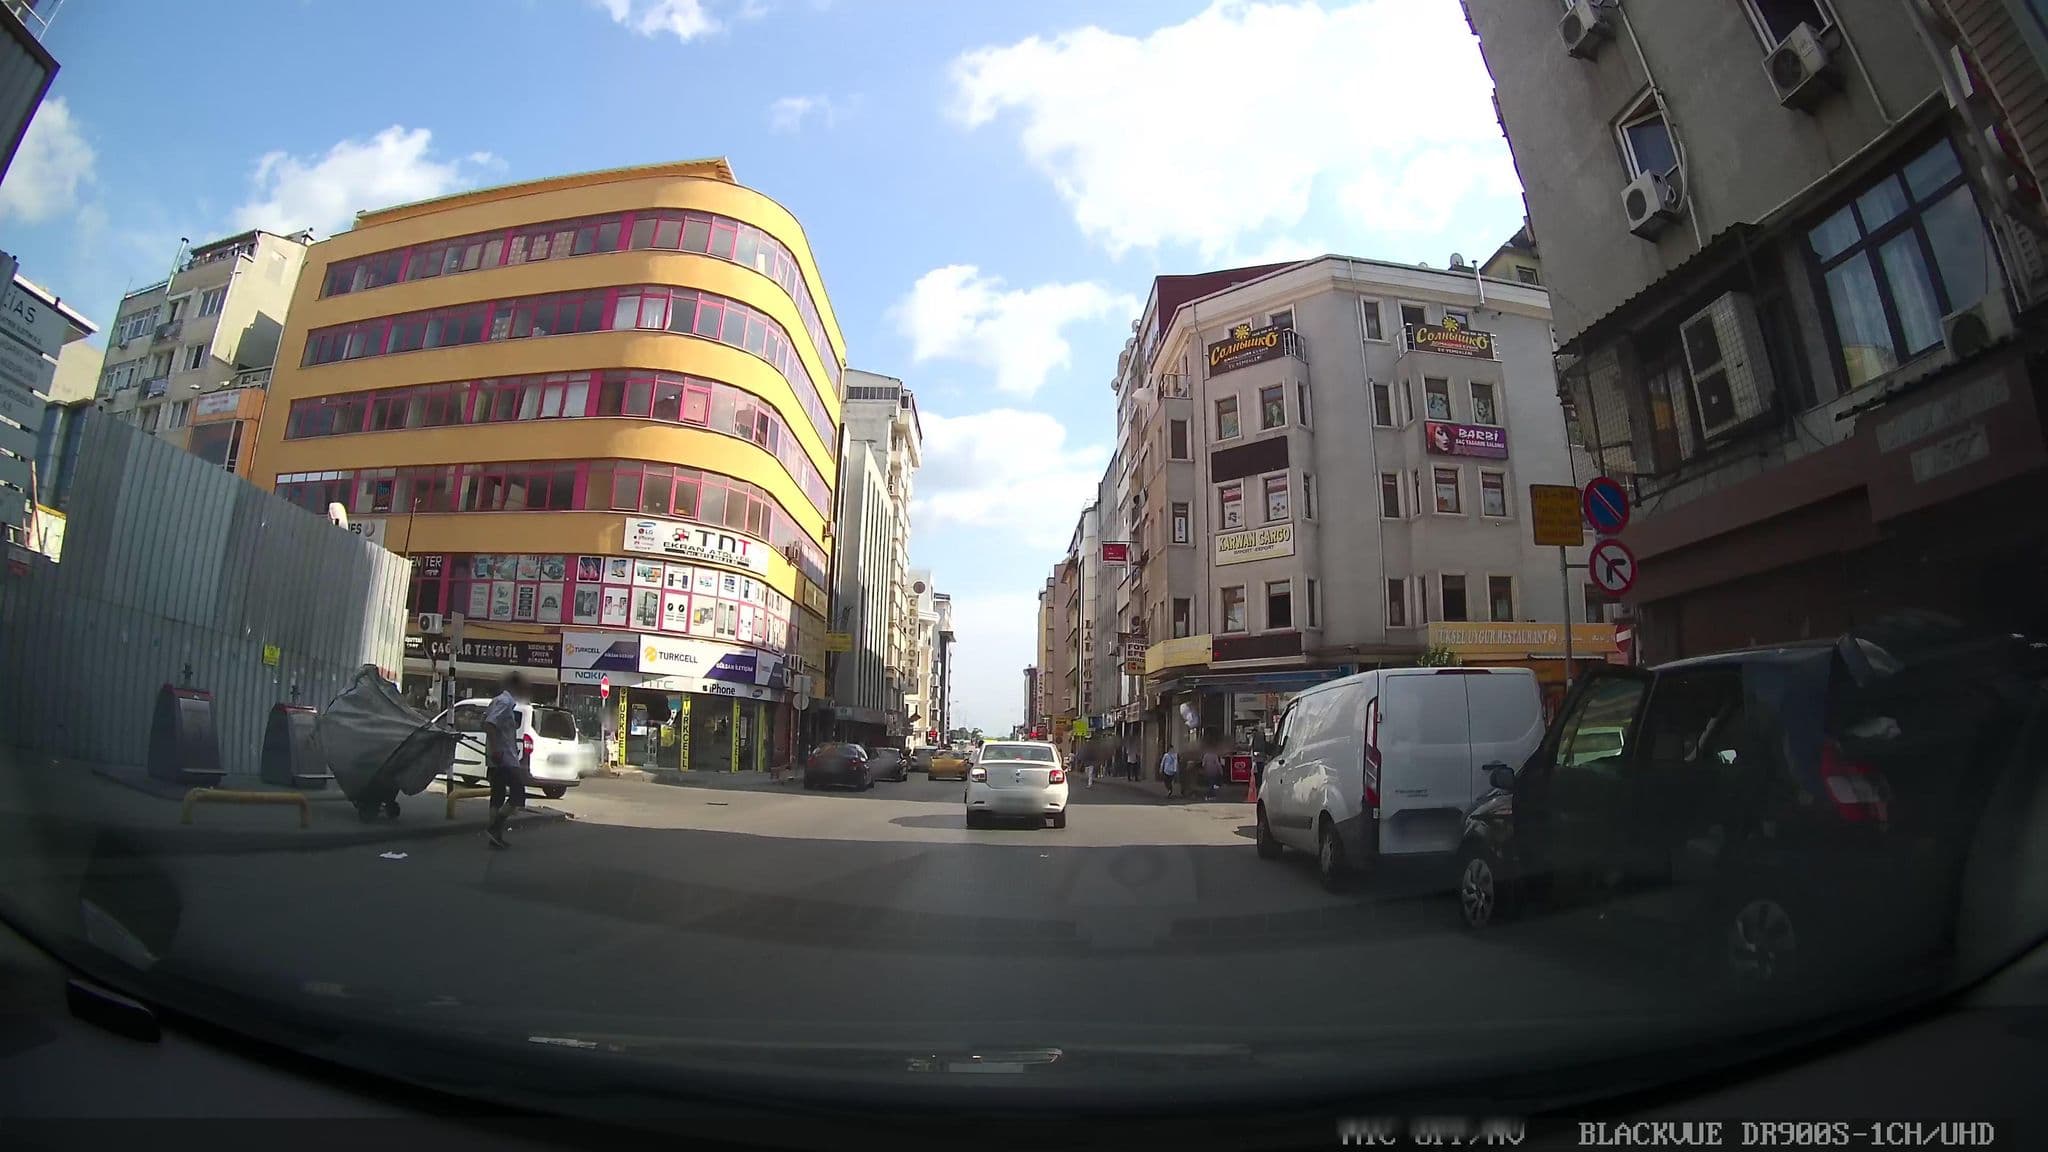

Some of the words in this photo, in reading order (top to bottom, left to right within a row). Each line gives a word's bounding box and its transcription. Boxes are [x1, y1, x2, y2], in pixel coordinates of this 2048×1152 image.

[1219, 531, 1257, 552] KARWAN
[1259, 527, 1291, 546] CARGO
[474, 643, 519, 658] TEKSTİL
[574, 646, 600, 654] TURKCELL
[658, 651, 699, 664] TURKCELL
[575, 671, 608, 680] NOKIA
[709, 685, 736, 696] iPhone
[618, 695, 626, 766] TURKCELL
